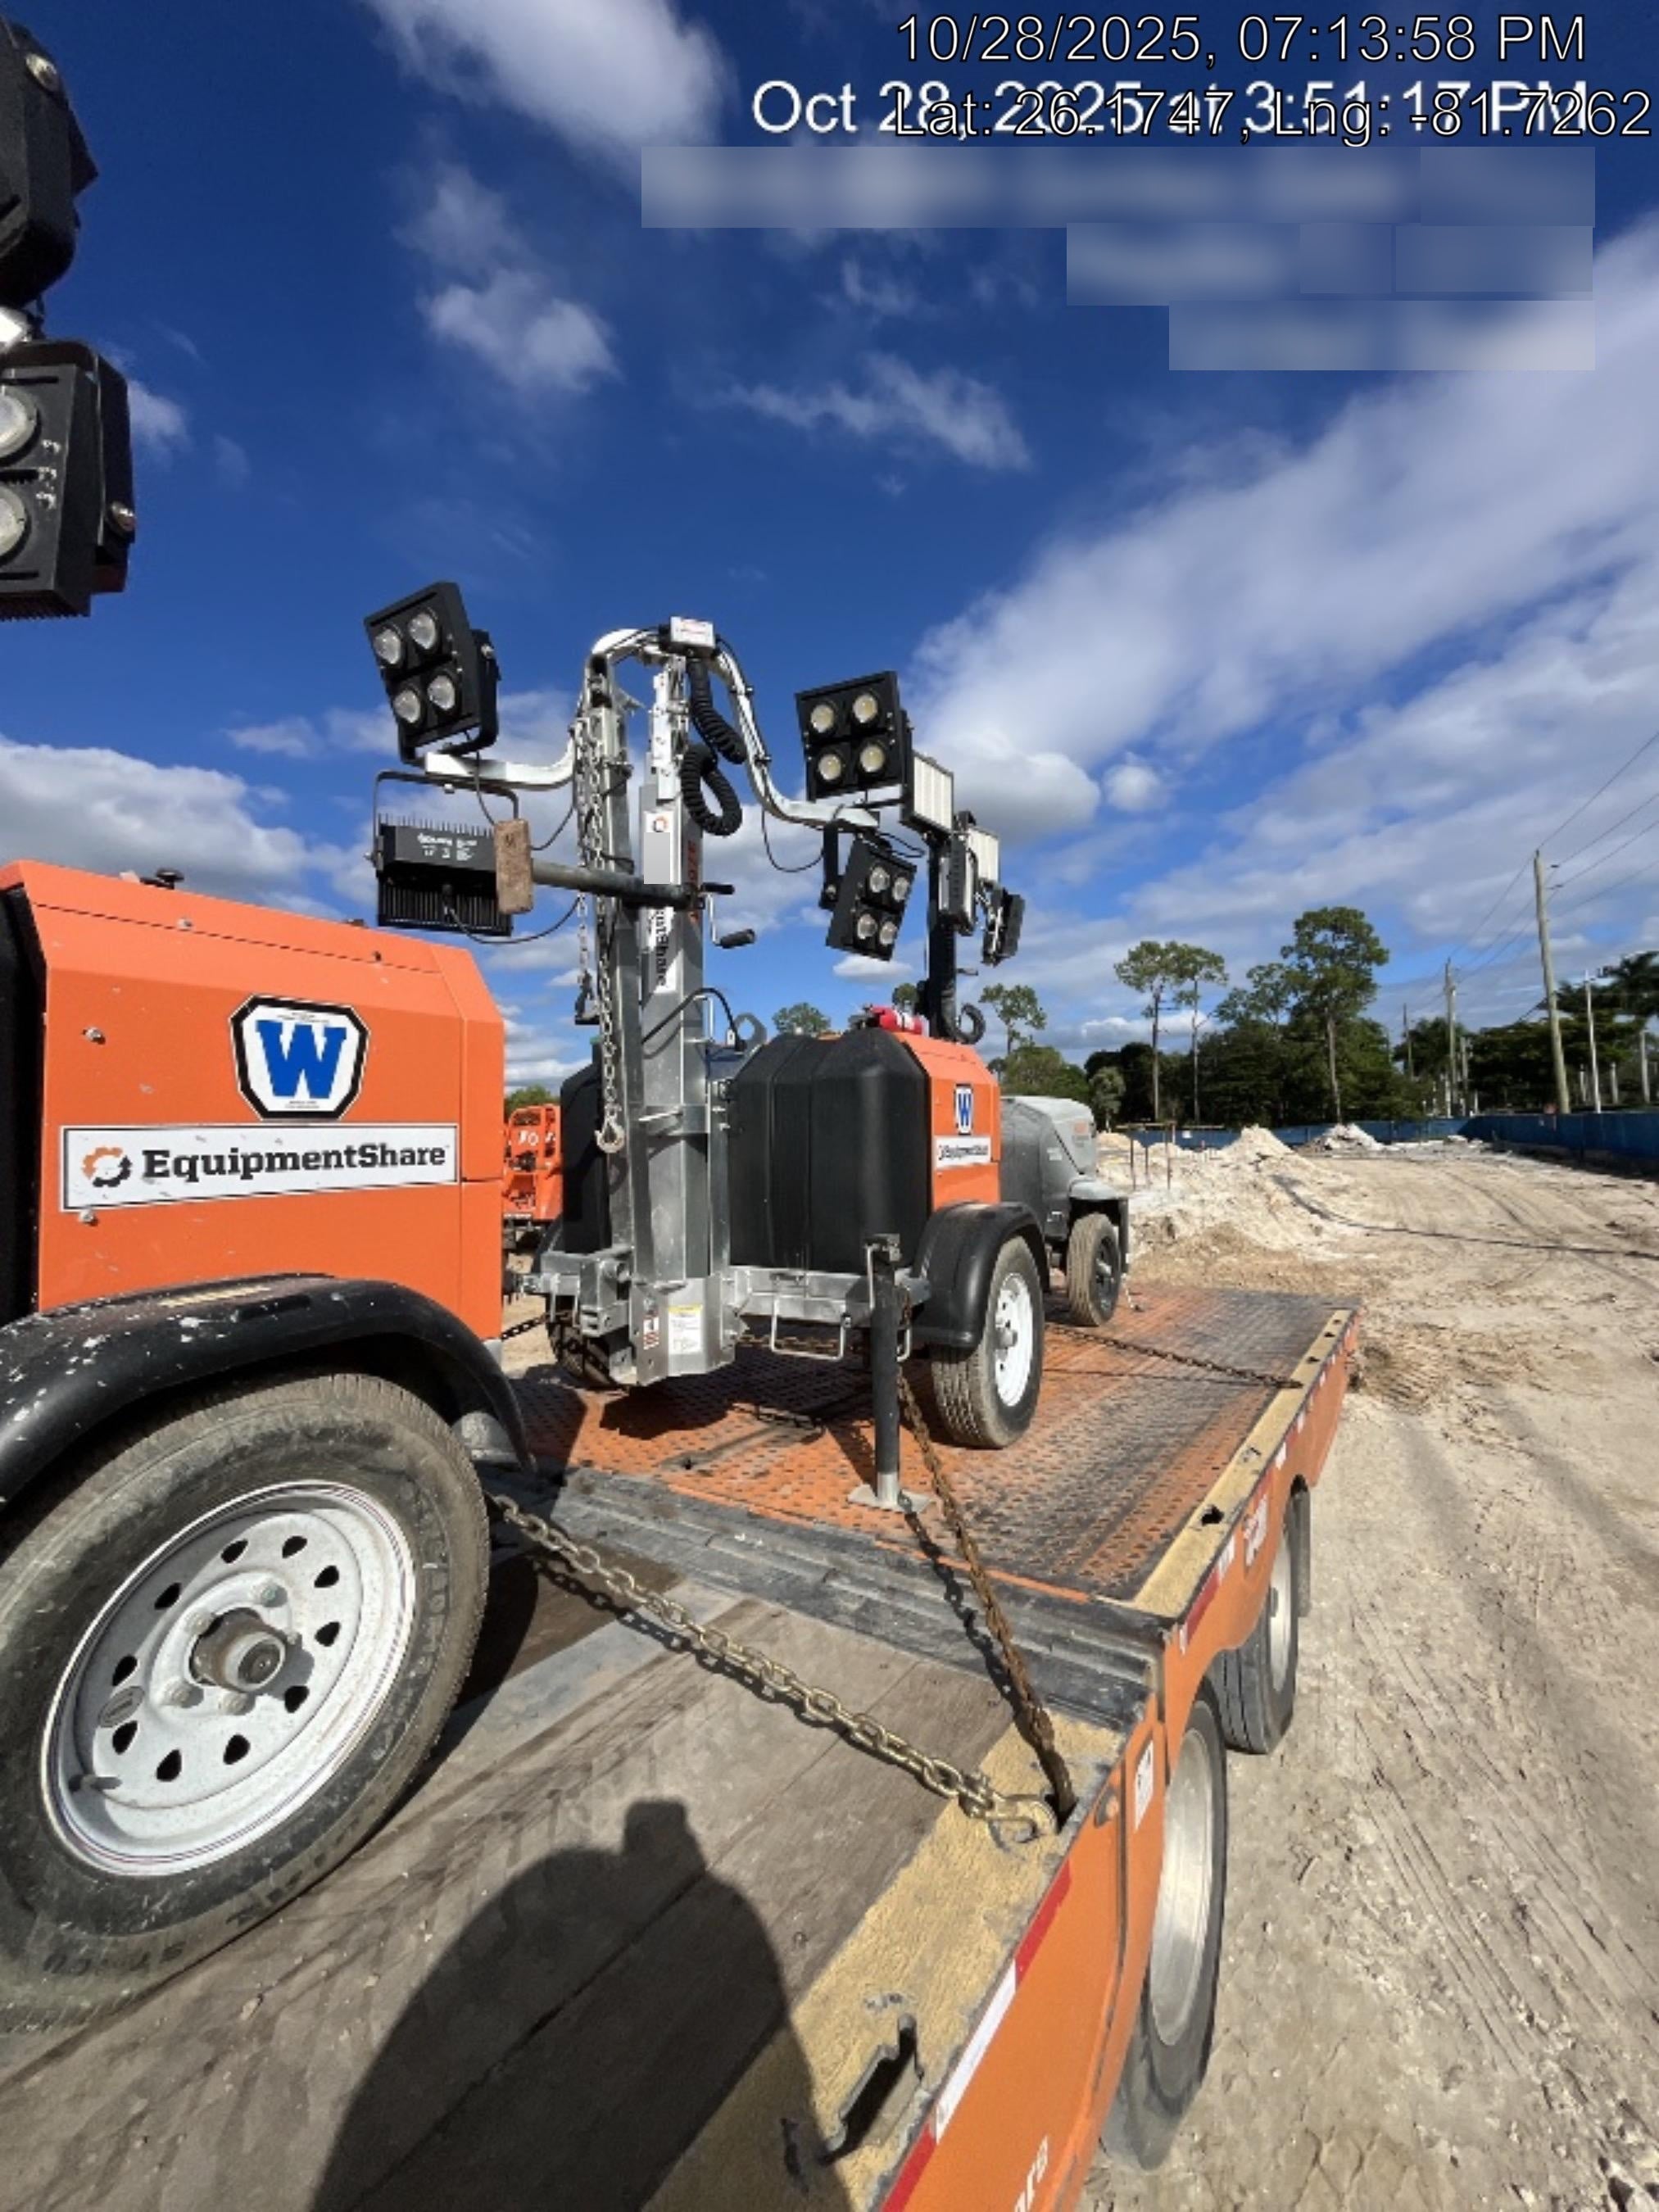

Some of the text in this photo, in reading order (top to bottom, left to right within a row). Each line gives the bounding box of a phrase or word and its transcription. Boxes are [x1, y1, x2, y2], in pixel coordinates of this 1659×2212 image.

[256, 1020, 347, 1099] W
[957, 1093, 972, 1126] W
[141, 1142, 446, 1183] EquipmentShare
